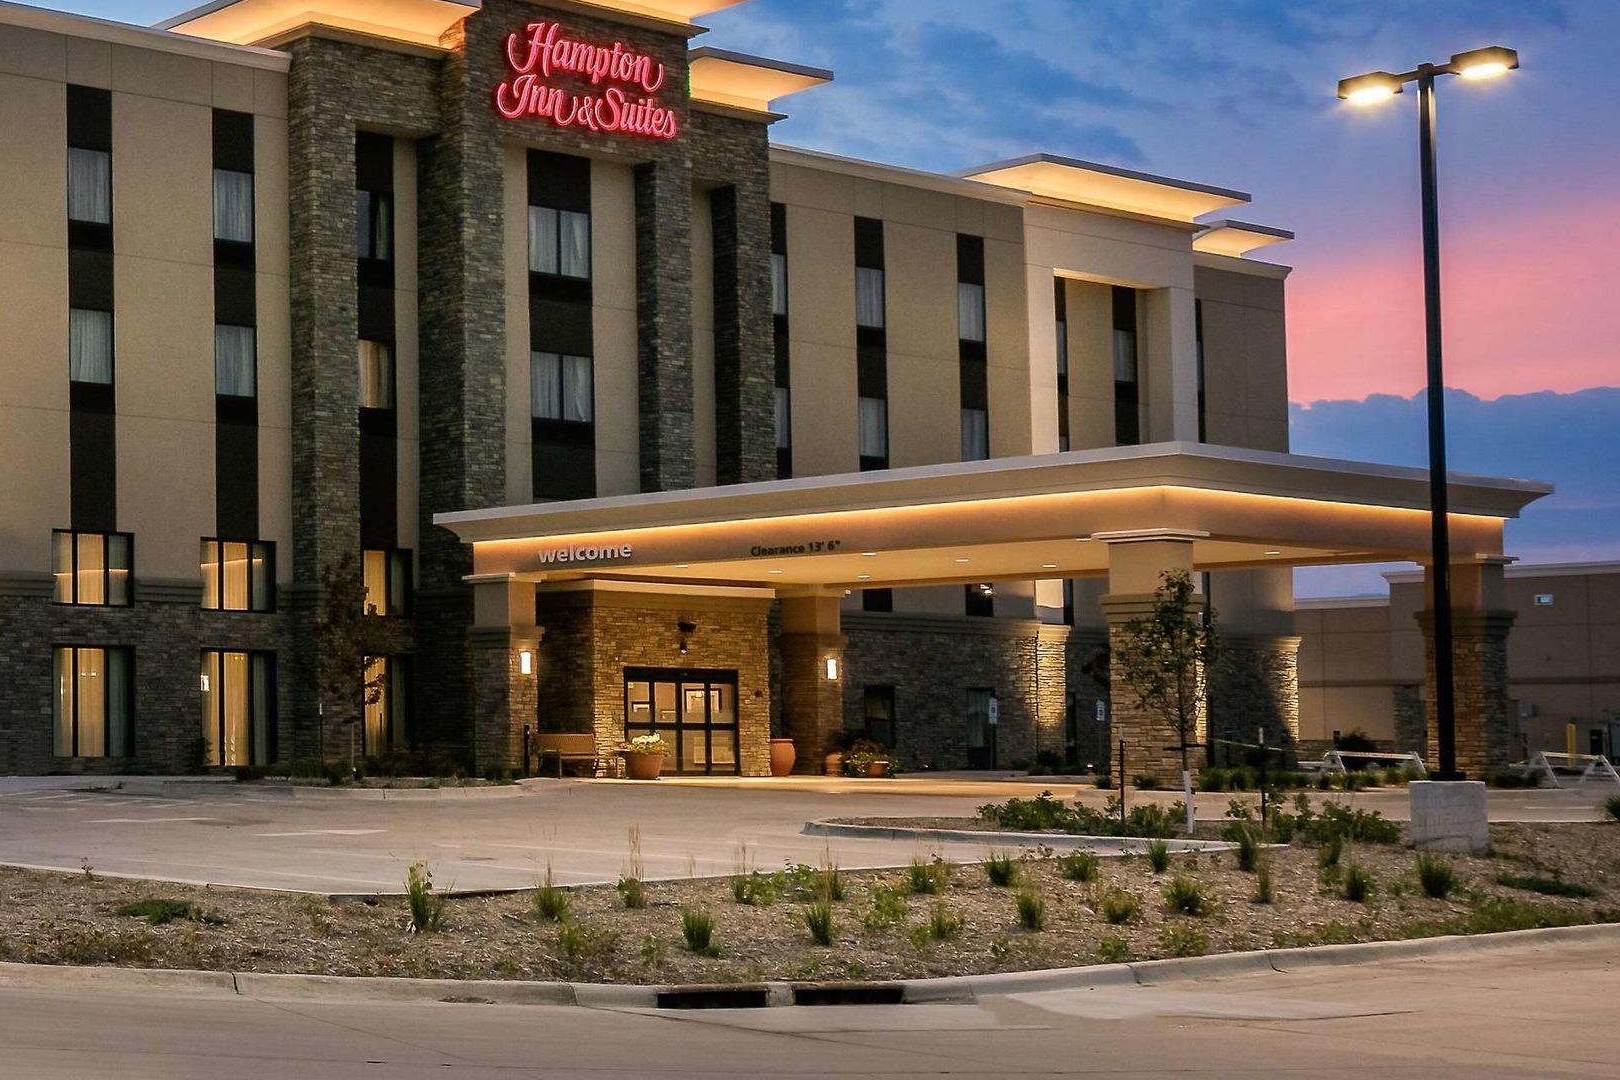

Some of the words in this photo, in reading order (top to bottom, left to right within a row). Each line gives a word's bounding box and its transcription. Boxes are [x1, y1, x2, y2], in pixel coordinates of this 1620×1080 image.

[507, 22, 664, 93] Hampton
[497, 73, 579, 126] Inn
[577, 96, 599, 131] &
[594, 87, 678, 139] Suites
[538, 543, 632, 563] welcome
[750, 545, 805, 557] Clearance
